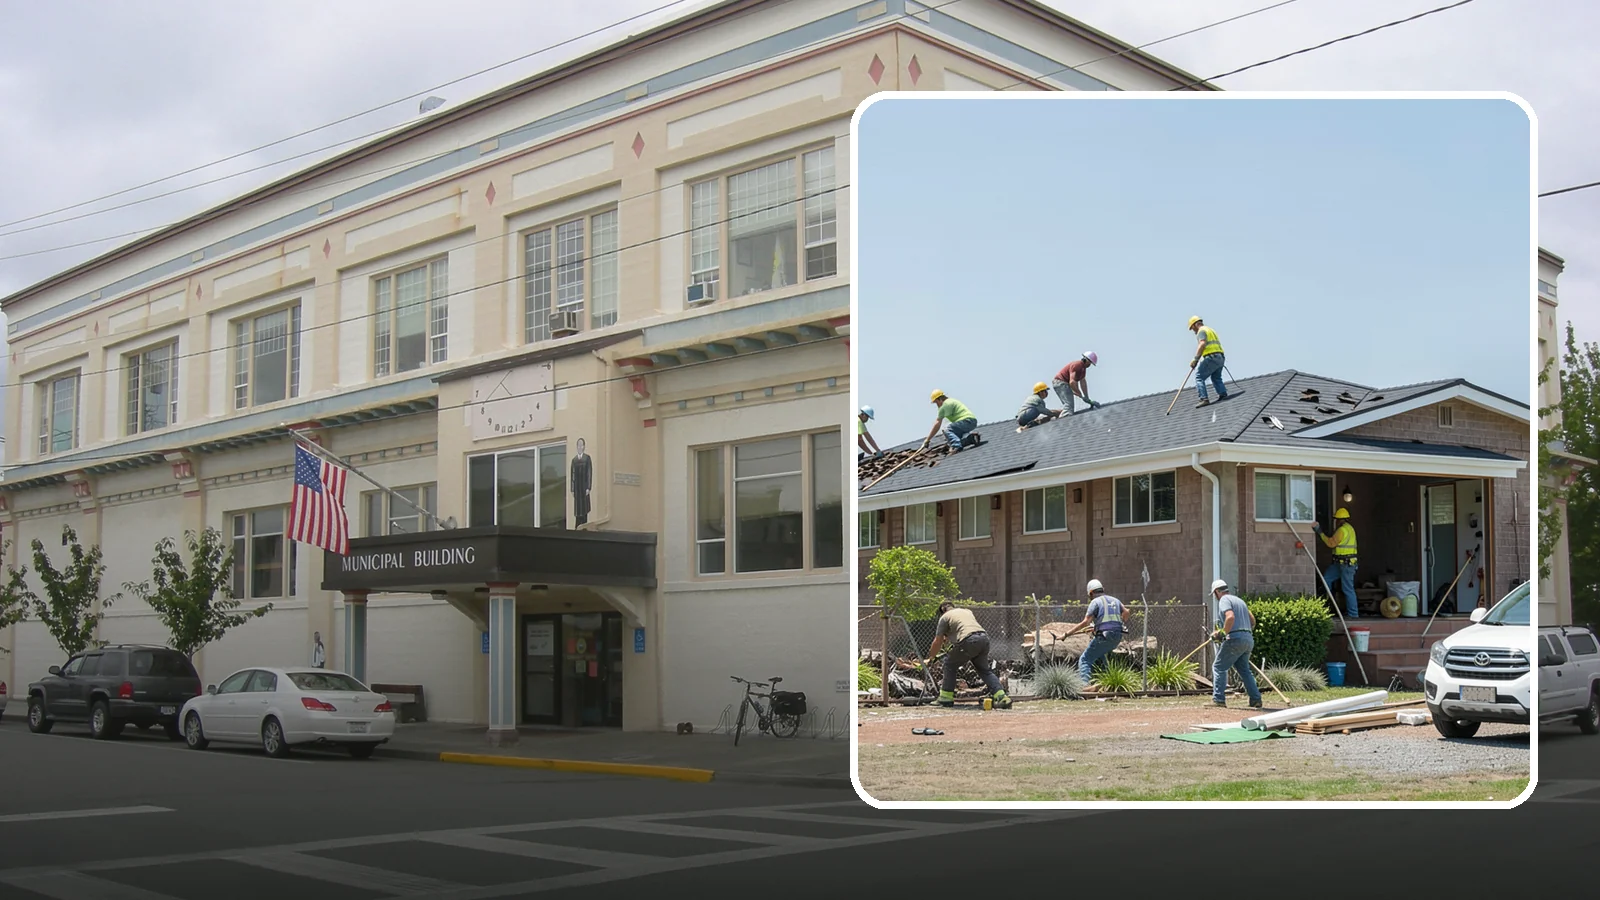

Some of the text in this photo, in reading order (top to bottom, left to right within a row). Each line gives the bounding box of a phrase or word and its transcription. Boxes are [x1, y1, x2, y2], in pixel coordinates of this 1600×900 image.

[495, 424, 500, 432] 10
[507, 425, 513, 433] 12
[342, 546, 475, 572] MUNICIPAL BUILDING
